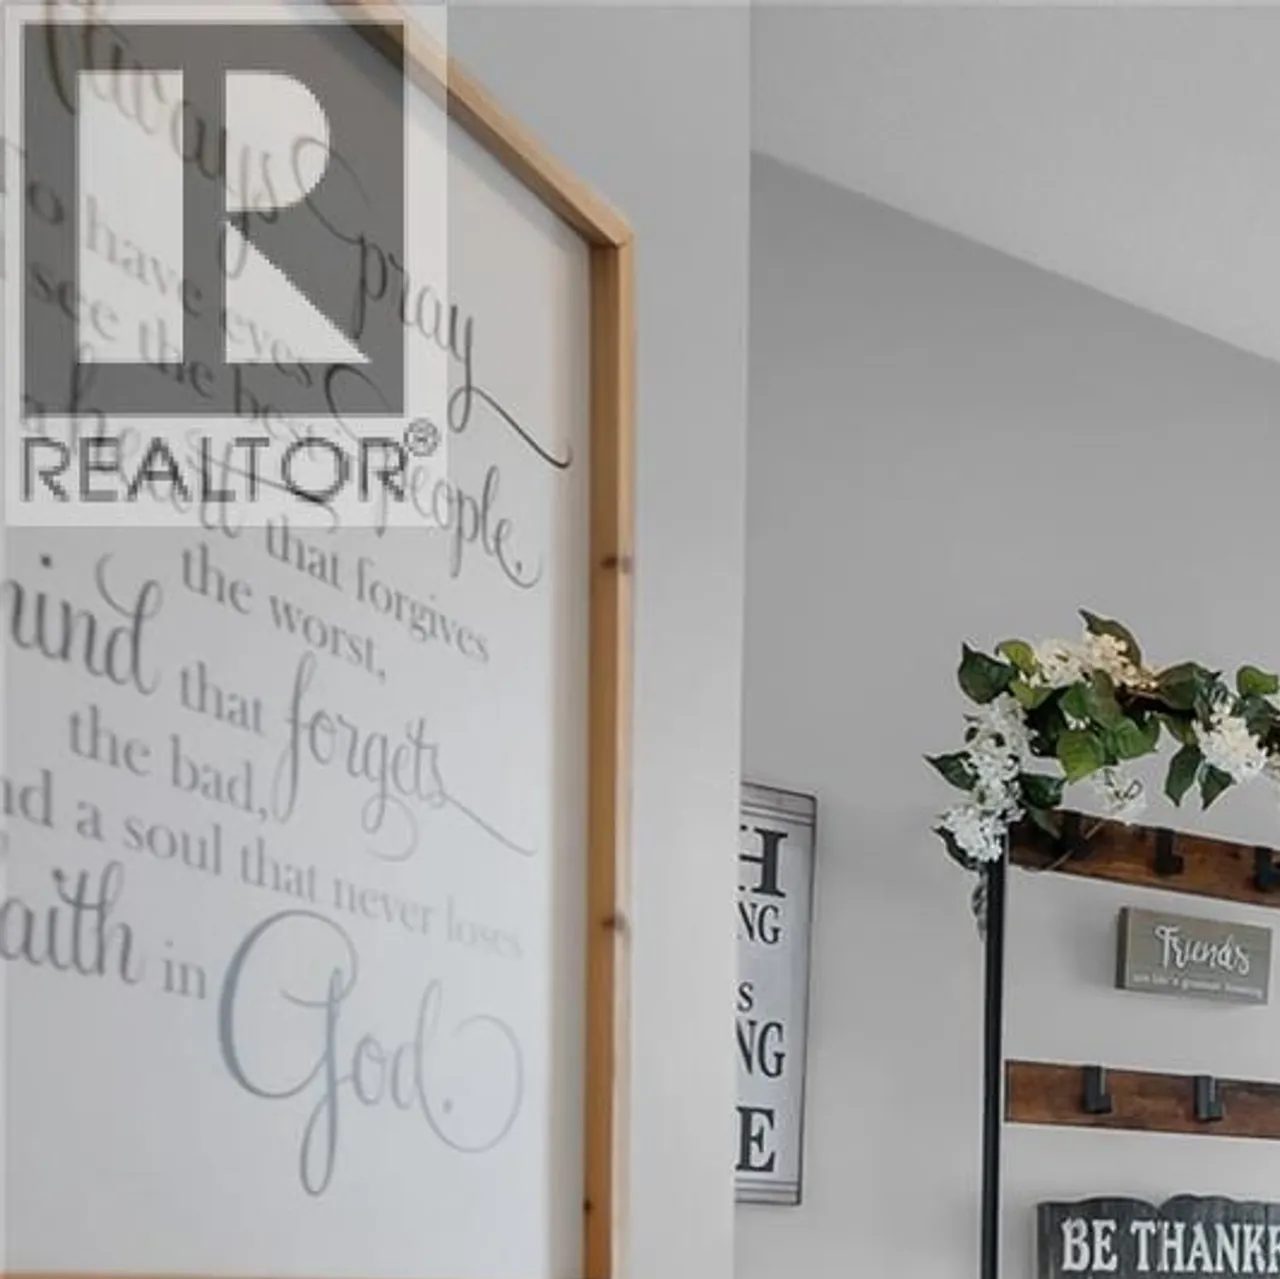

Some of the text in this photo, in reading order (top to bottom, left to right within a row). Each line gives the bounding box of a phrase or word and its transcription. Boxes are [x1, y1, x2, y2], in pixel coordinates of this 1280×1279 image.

[181, 540, 254, 615] the
[265, 514, 342, 589] that
[357, 553, 490, 664] forgives
[179, 660, 265, 736] that
[68, 703, 269, 822] the bad,
[0, 858, 147, 985] aith
[162, 939, 208, 1002] in
[76, 800, 105, 842] a
[122, 814, 223, 877] soul
[239, 837, 318, 904] that
[332, 876, 432, 936] never
[446, 901, 525, 962] loses
[1060, 1217, 1118, 1272] BE
